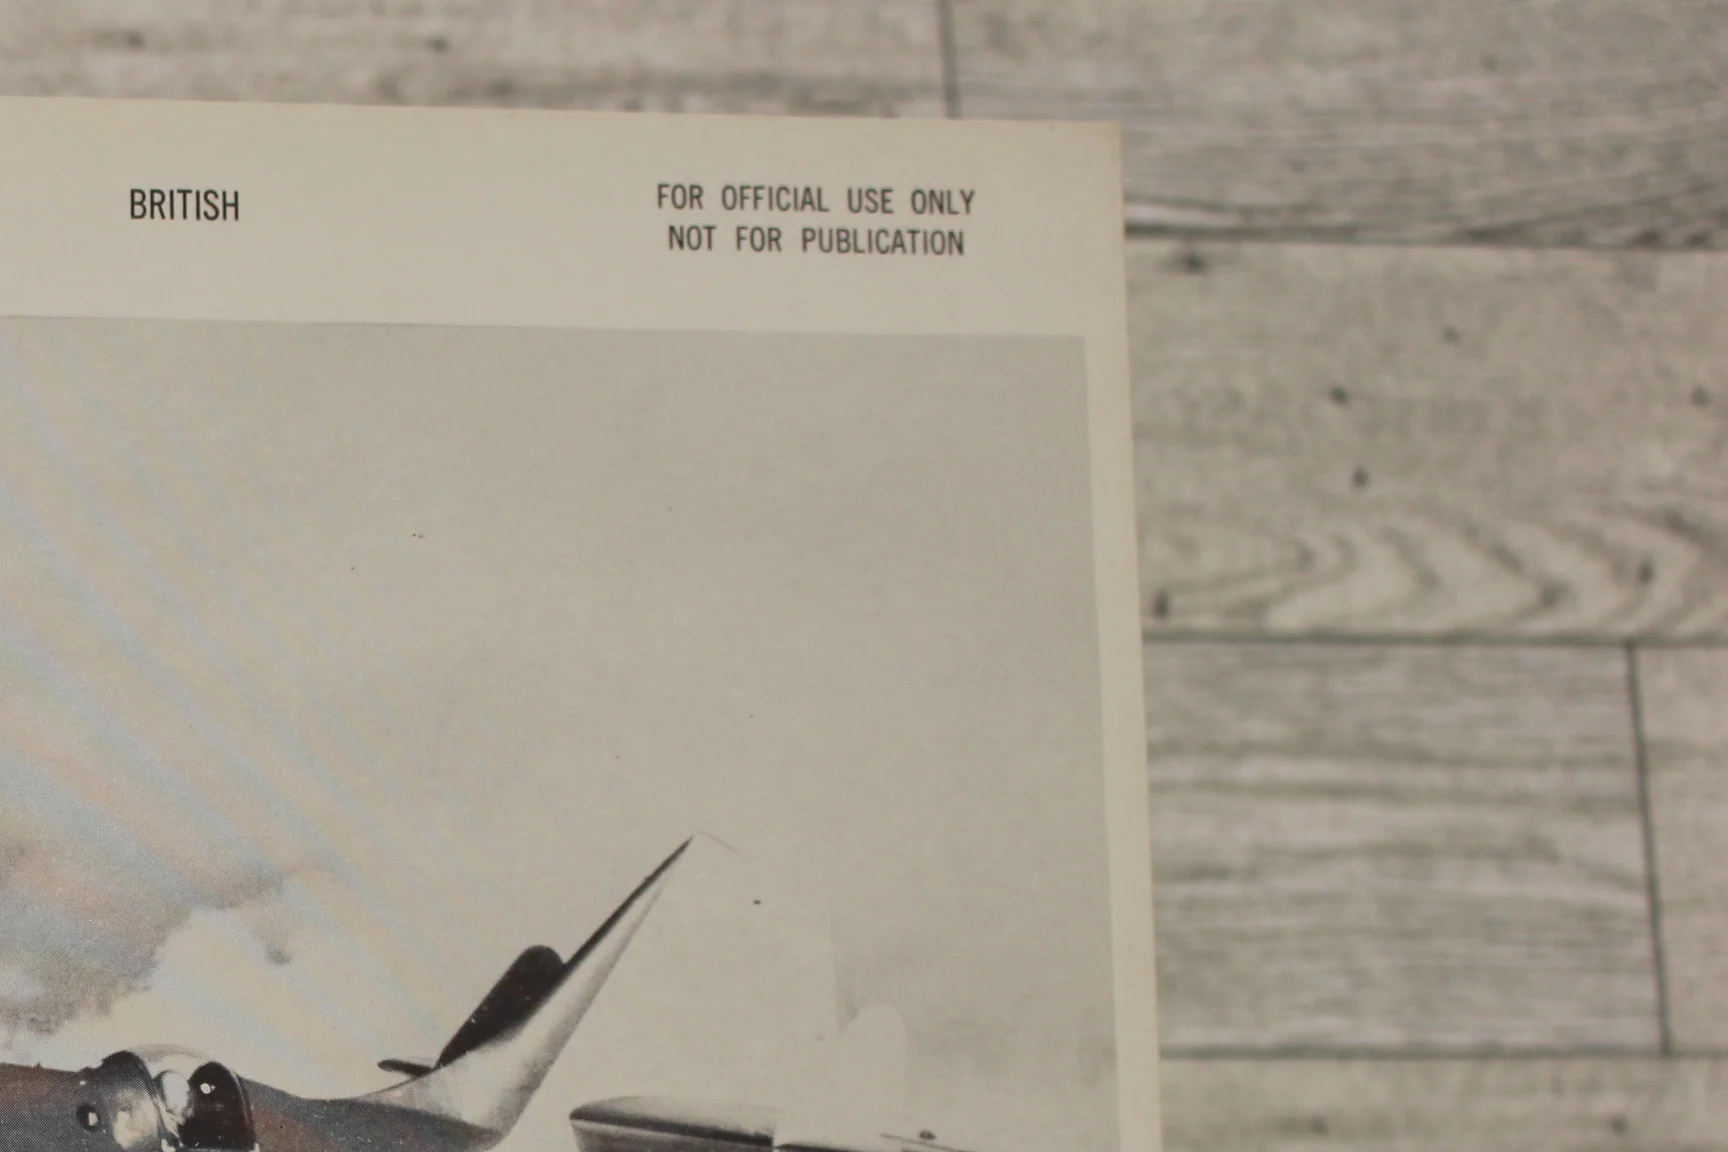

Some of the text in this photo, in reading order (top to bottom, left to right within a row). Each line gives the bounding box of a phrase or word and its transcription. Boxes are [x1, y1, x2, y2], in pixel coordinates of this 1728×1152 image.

[130, 188, 239, 221] BRITISH
[657, 183, 975, 215] FOR OFFICIAL USE ONLY
[668, 225, 965, 256] NOT FOR PUBLICATION
